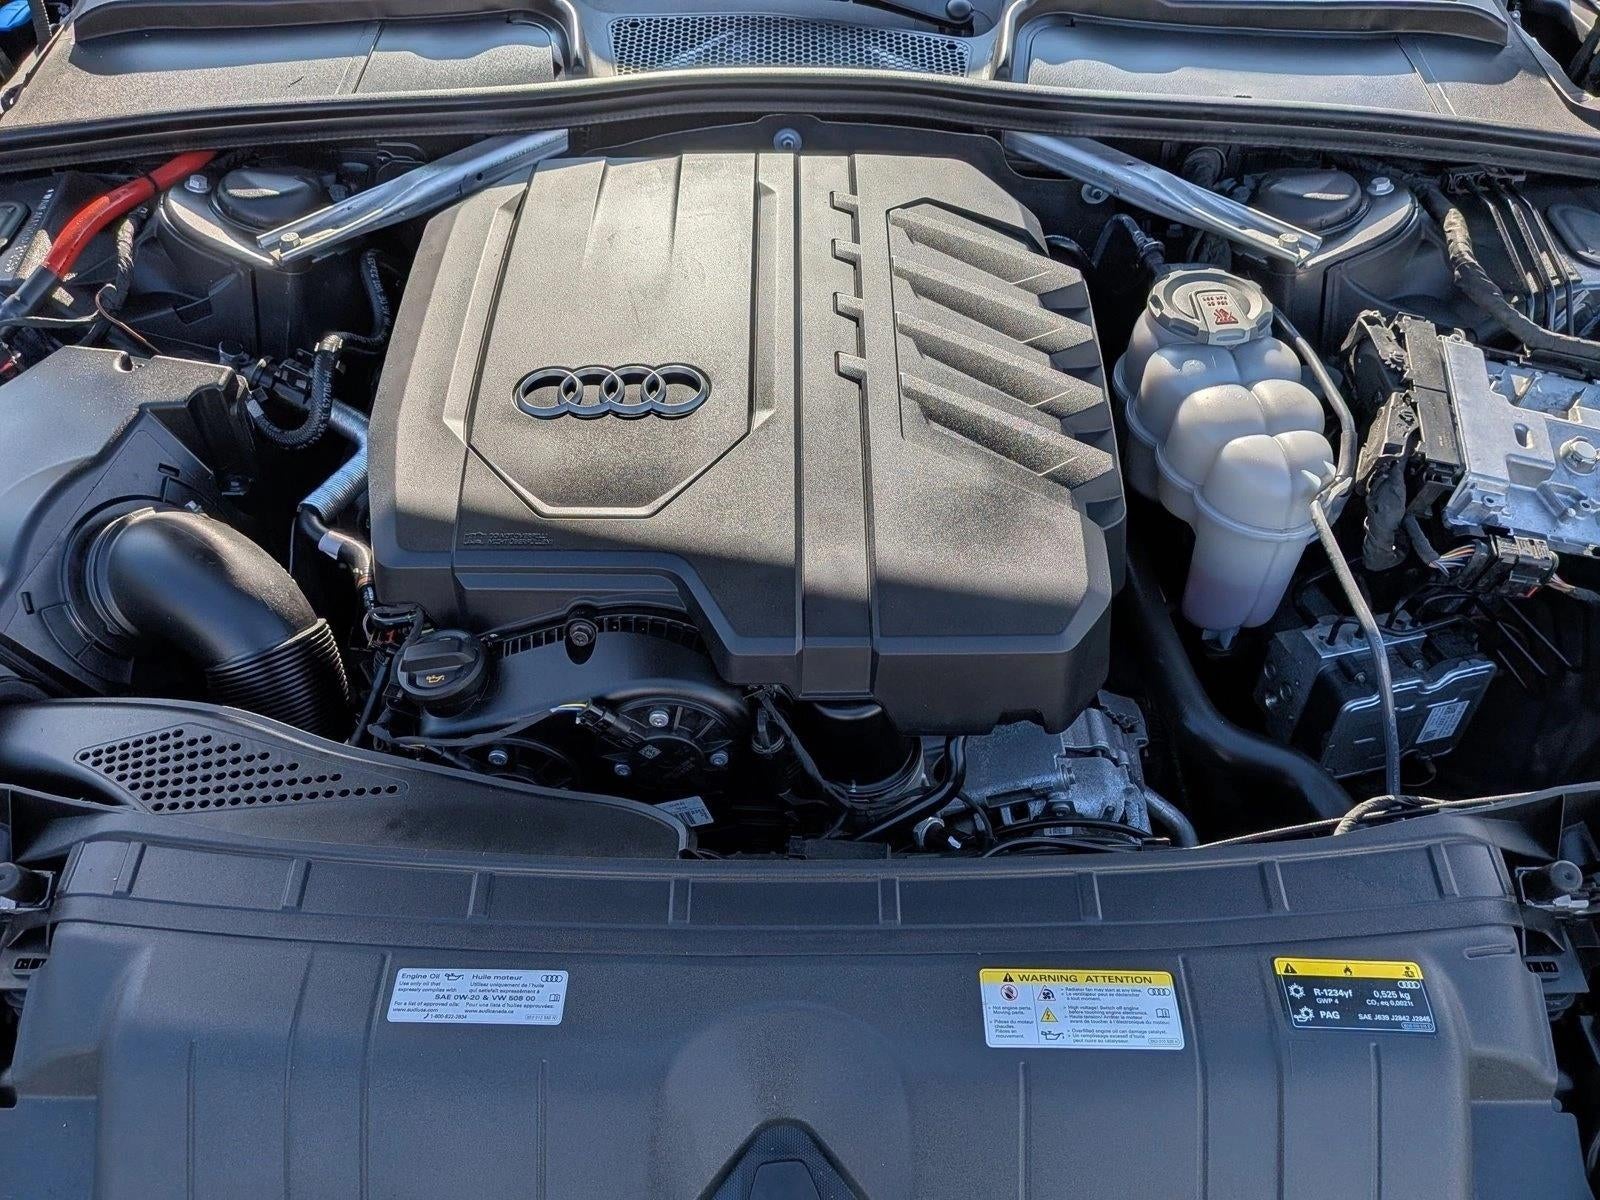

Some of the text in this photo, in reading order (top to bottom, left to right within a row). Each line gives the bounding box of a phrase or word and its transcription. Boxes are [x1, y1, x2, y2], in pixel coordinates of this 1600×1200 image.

[1018, 974, 1152, 984] WARNING ATTENTION
[1313, 988, 1353, 998] R-1234yf
[1399, 991, 1411, 1000] kg
[1319, 1011, 1340, 1019] PAG
